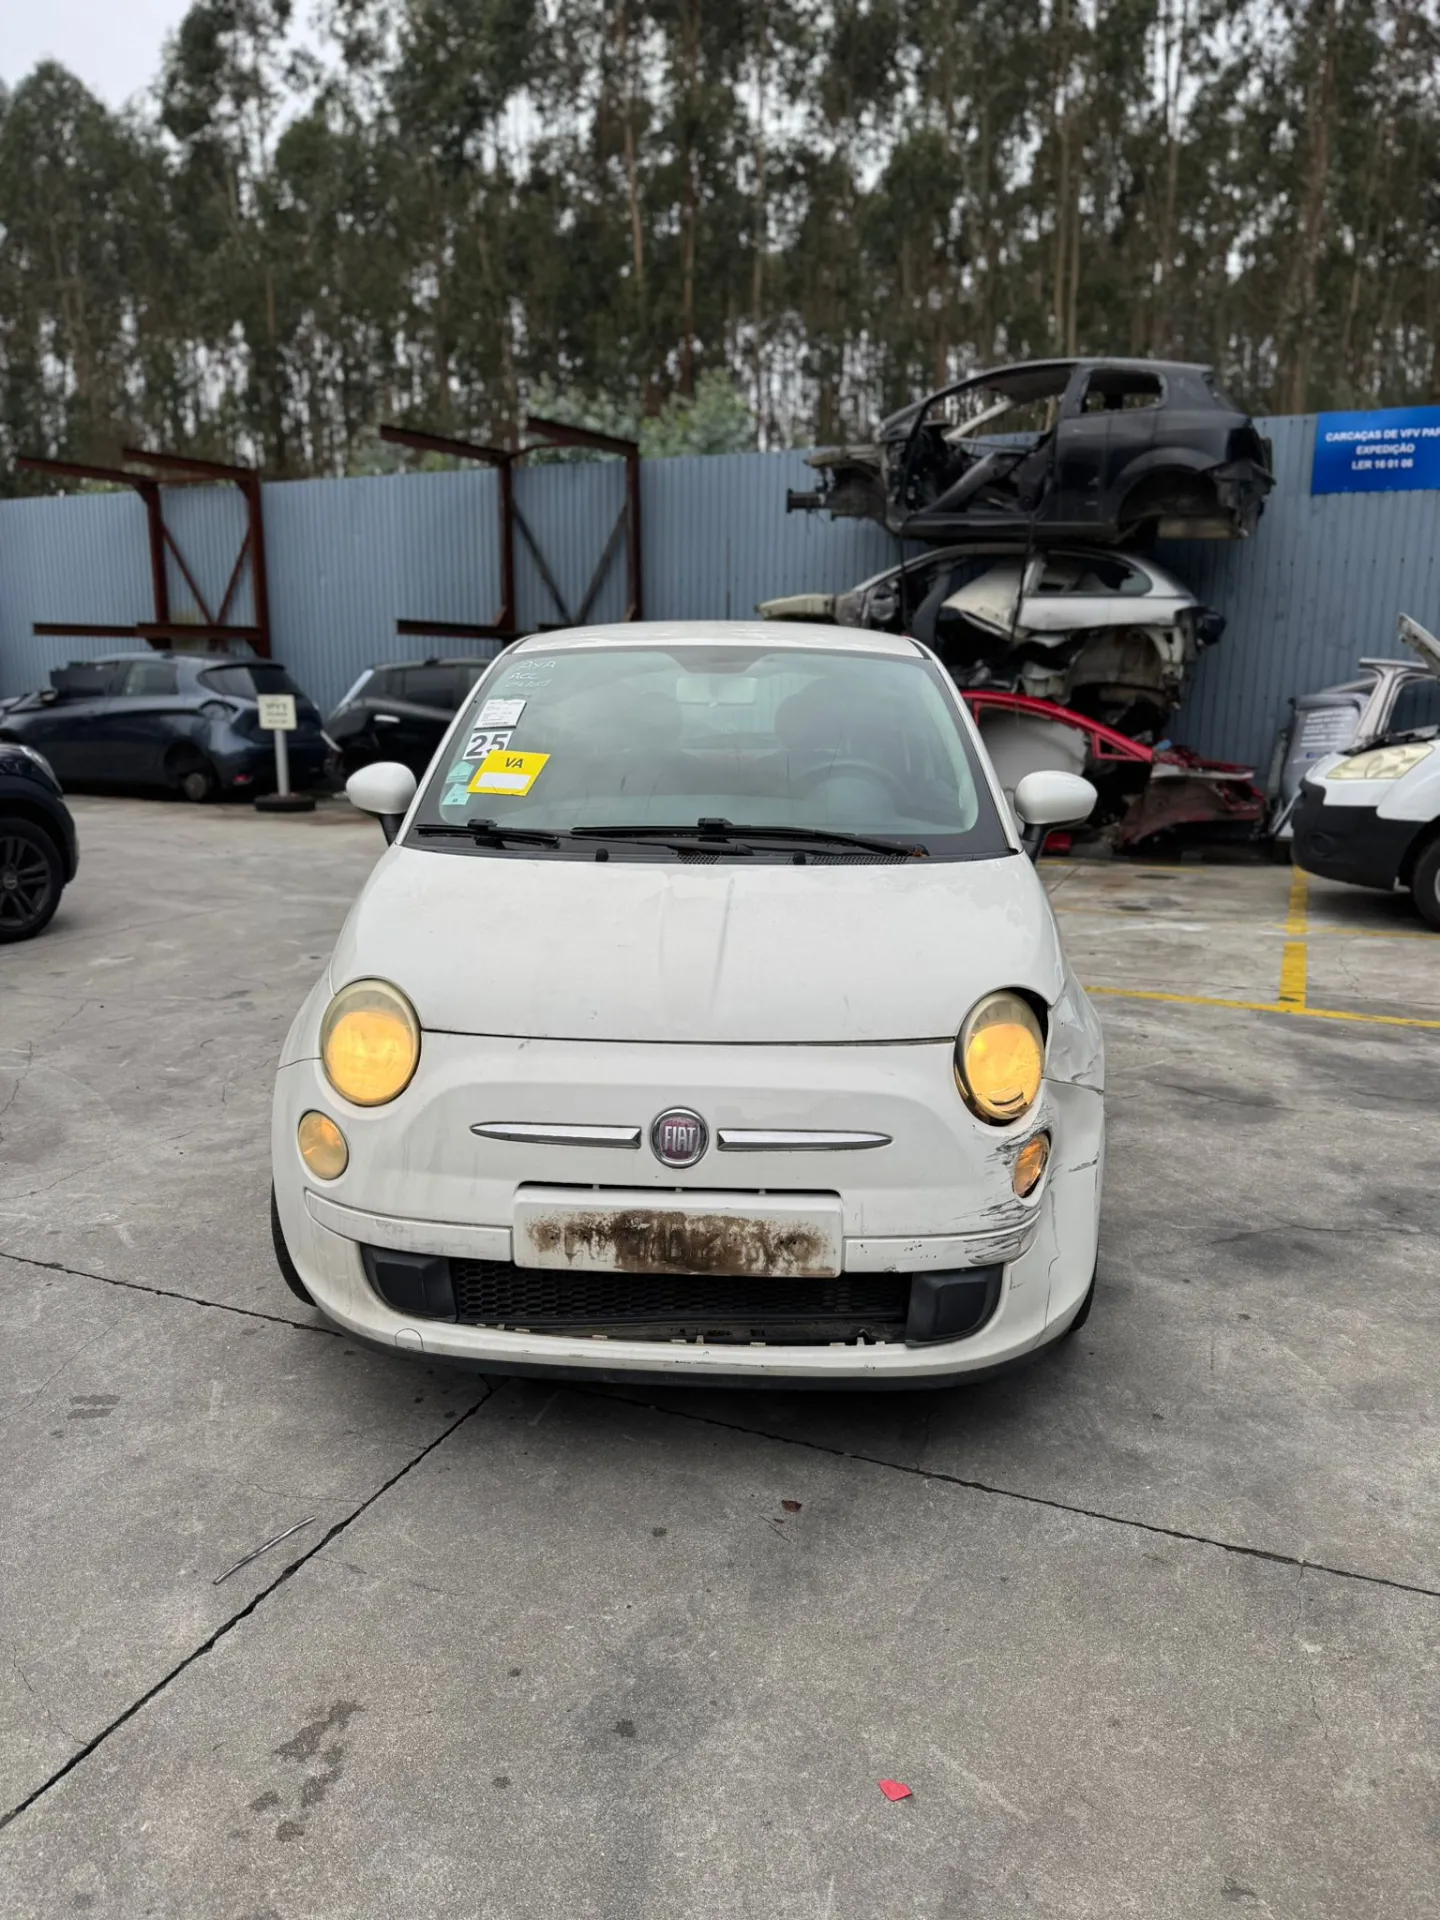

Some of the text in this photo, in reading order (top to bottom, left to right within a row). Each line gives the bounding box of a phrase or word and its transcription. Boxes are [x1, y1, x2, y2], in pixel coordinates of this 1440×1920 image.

[1326, 430, 1382, 441] CARCAÇAS
[1384, 429, 1398, 440] DE
[1400, 428, 1421, 438] VFV
[1356, 443, 1415, 455] EXPEDIÇÃO
[1351, 460, 1372, 470] LER
[466, 733, 509, 757] 25
[505, 757, 524, 769] VA
[665, 1126, 696, 1151] FIAT
